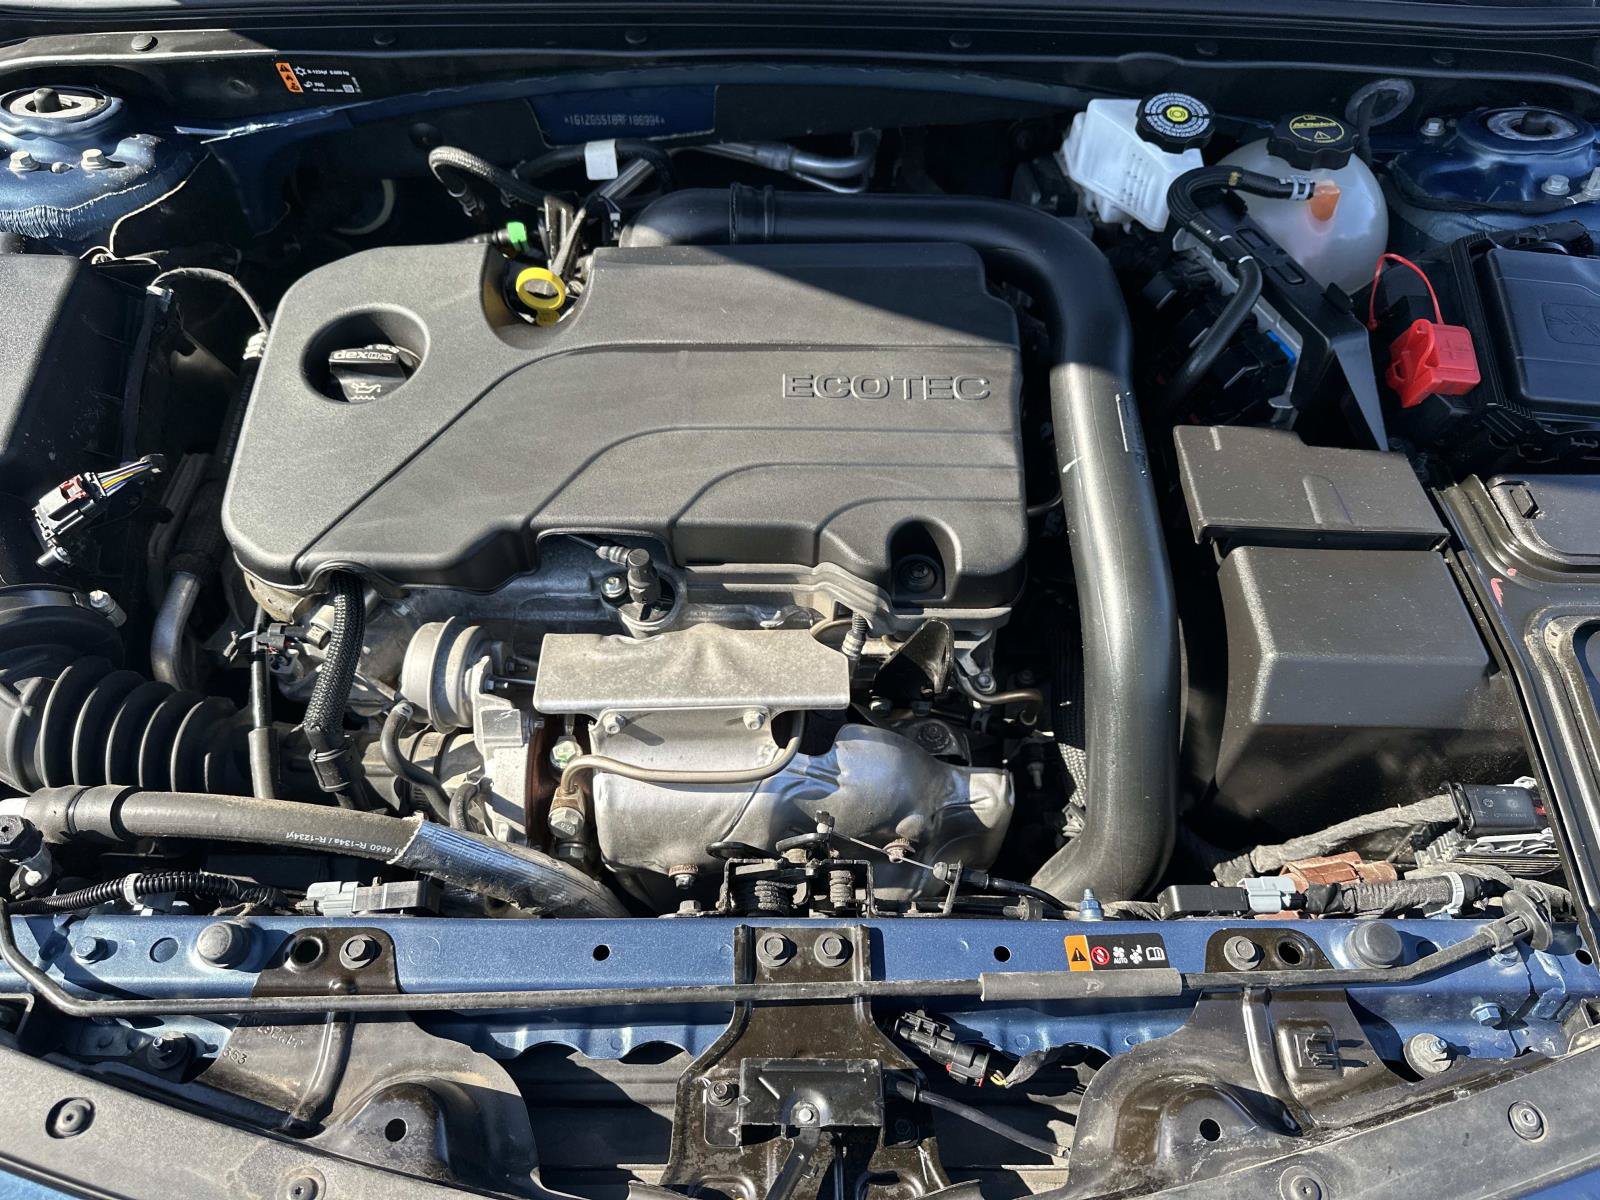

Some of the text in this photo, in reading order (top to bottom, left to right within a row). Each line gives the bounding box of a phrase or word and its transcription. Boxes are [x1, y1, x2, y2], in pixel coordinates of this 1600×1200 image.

[333, 350, 393, 361] dexos
[782, 373, 991, 401] ECOTEC
[334, 837, 367, 850] R-134a
[1113, 957, 1129, 965] AUTO
